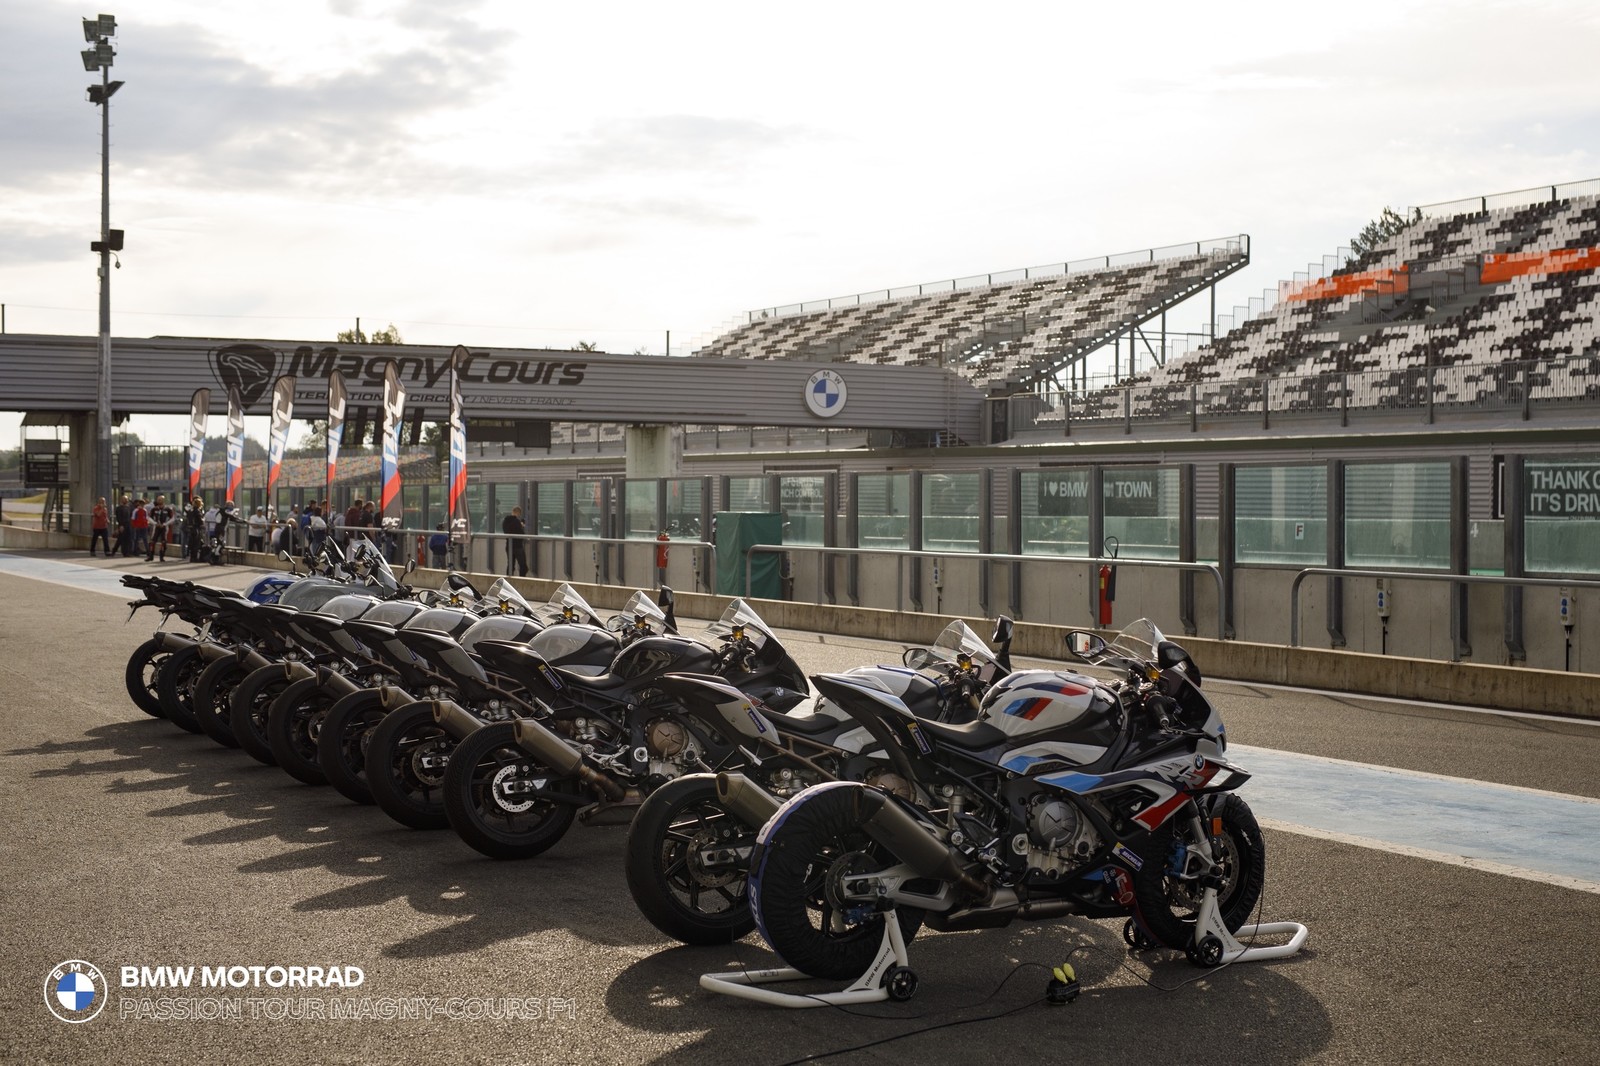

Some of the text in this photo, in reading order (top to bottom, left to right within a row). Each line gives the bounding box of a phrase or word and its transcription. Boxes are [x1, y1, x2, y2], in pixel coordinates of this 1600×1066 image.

[288, 345, 588, 389] Magny Cours
[811, 371, 842, 385] BMW
[410, 393, 469, 403] CIRCT
[1530, 470, 1591, 490] THANK
[1060, 481, 1089, 498] BMW
[1115, 481, 1152, 498] TOWN
[1530, 493, 1561, 512] IT'S
[1296, 525, 1303, 537] F
